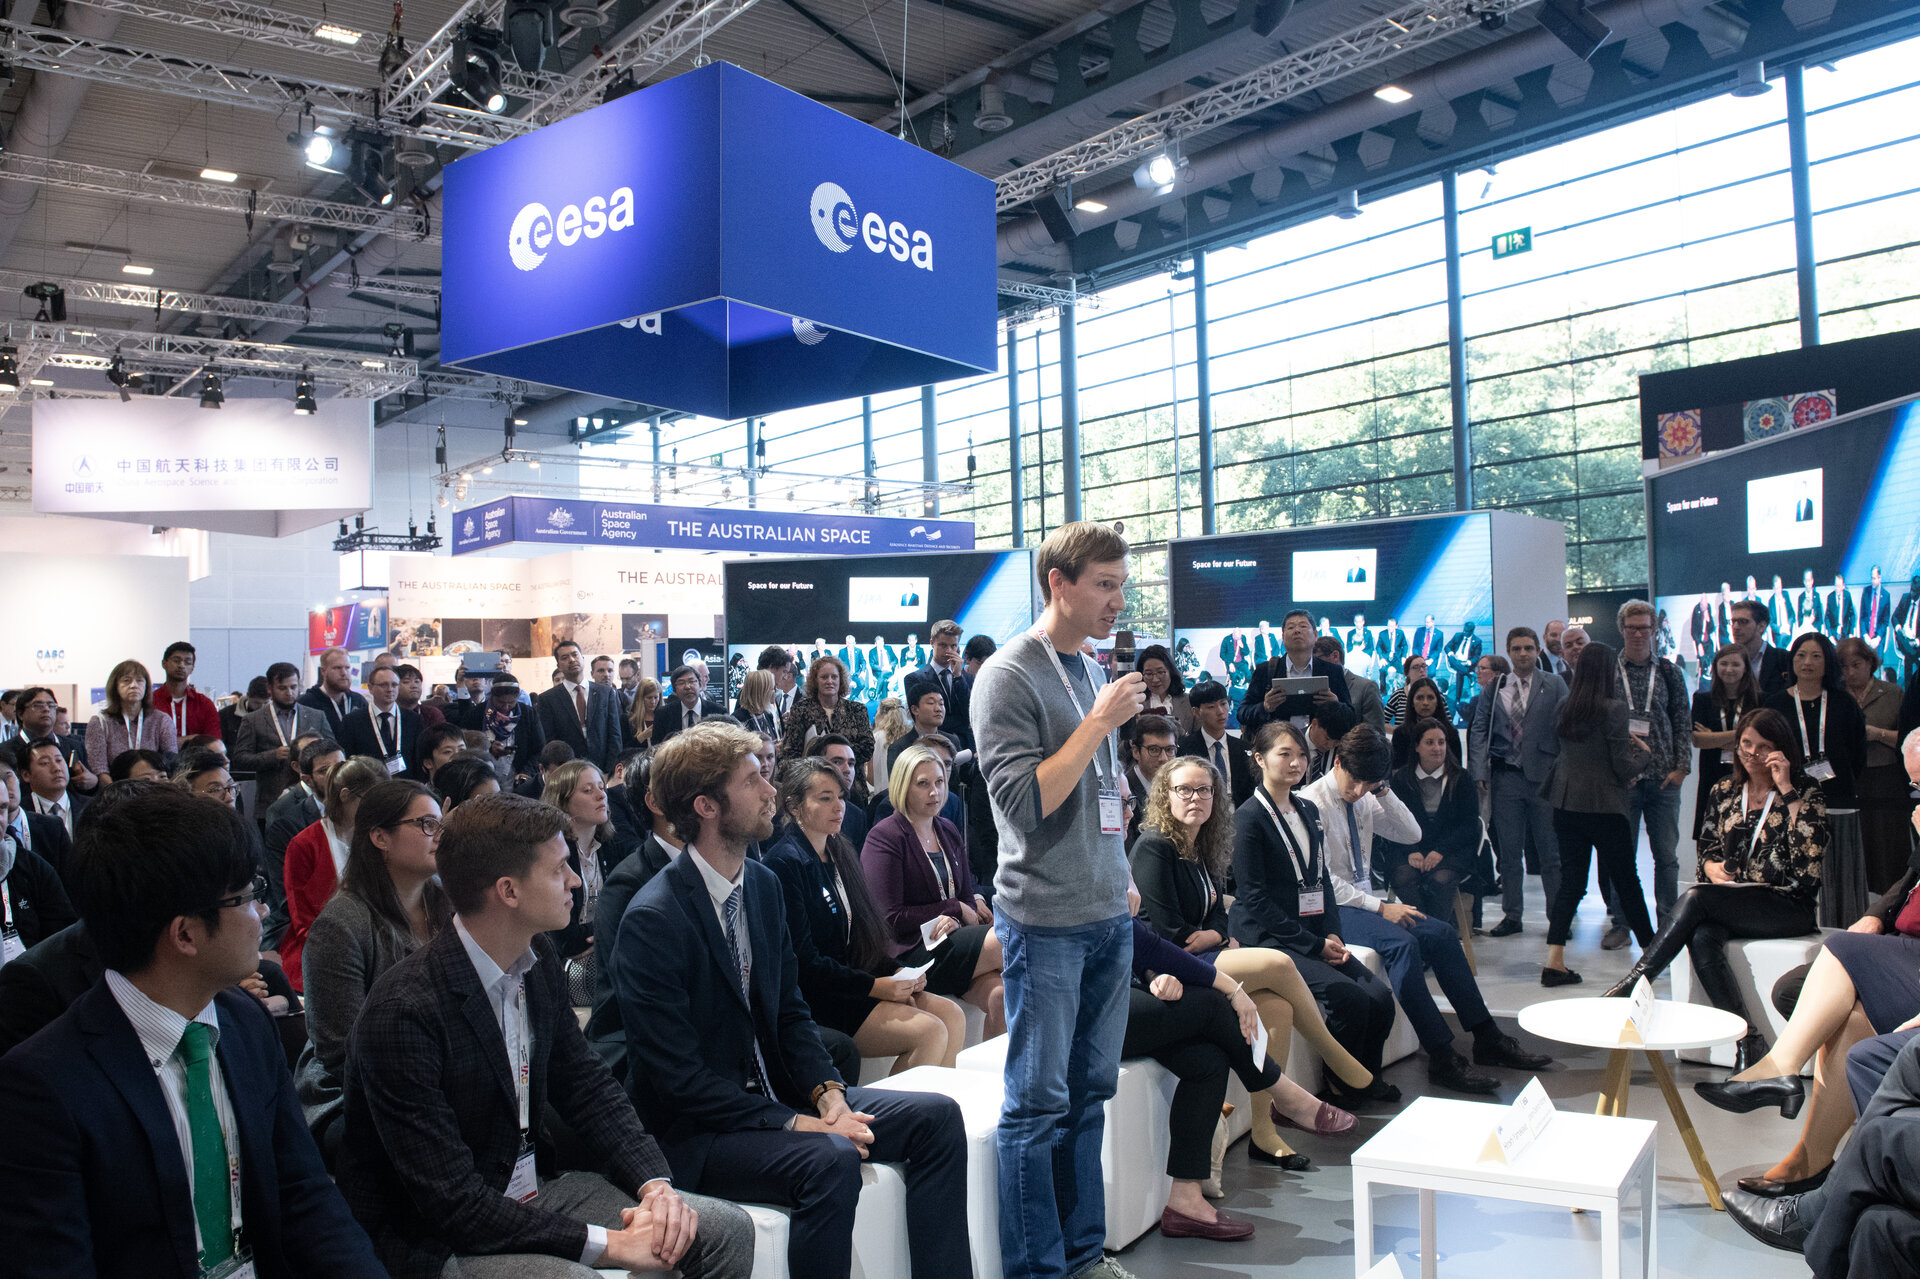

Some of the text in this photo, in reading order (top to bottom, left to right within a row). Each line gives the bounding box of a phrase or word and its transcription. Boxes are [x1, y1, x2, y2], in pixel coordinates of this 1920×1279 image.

[556, 186, 635, 247] esa
[862, 211, 934, 272] esa
[117, 456, 339, 474] 中国航天科技集团有限公司
[1666, 501, 1682, 514] Space
[1700, 496, 1718, 507] Future
[601, 508, 647, 521] Australian
[601, 519, 631, 529] Space
[601, 528, 637, 540] Agency
[667, 520, 871, 544] THE AUSTRALIAN SPACE
[1192, 560, 1211, 570] Space
[1212, 560, 1222, 568] for
[1235, 559, 1257, 567] Future
[618, 570, 648, 584] THE
[398, 580, 418, 590] THE
[421, 581, 487, 592] AUSTRALIAN
[489, 582, 521, 592] SPACE
[747, 582, 767, 590] Space
[768, 581, 778, 589] for
[792, 581, 814, 589] Future
[36, 649, 65, 659] CASC
